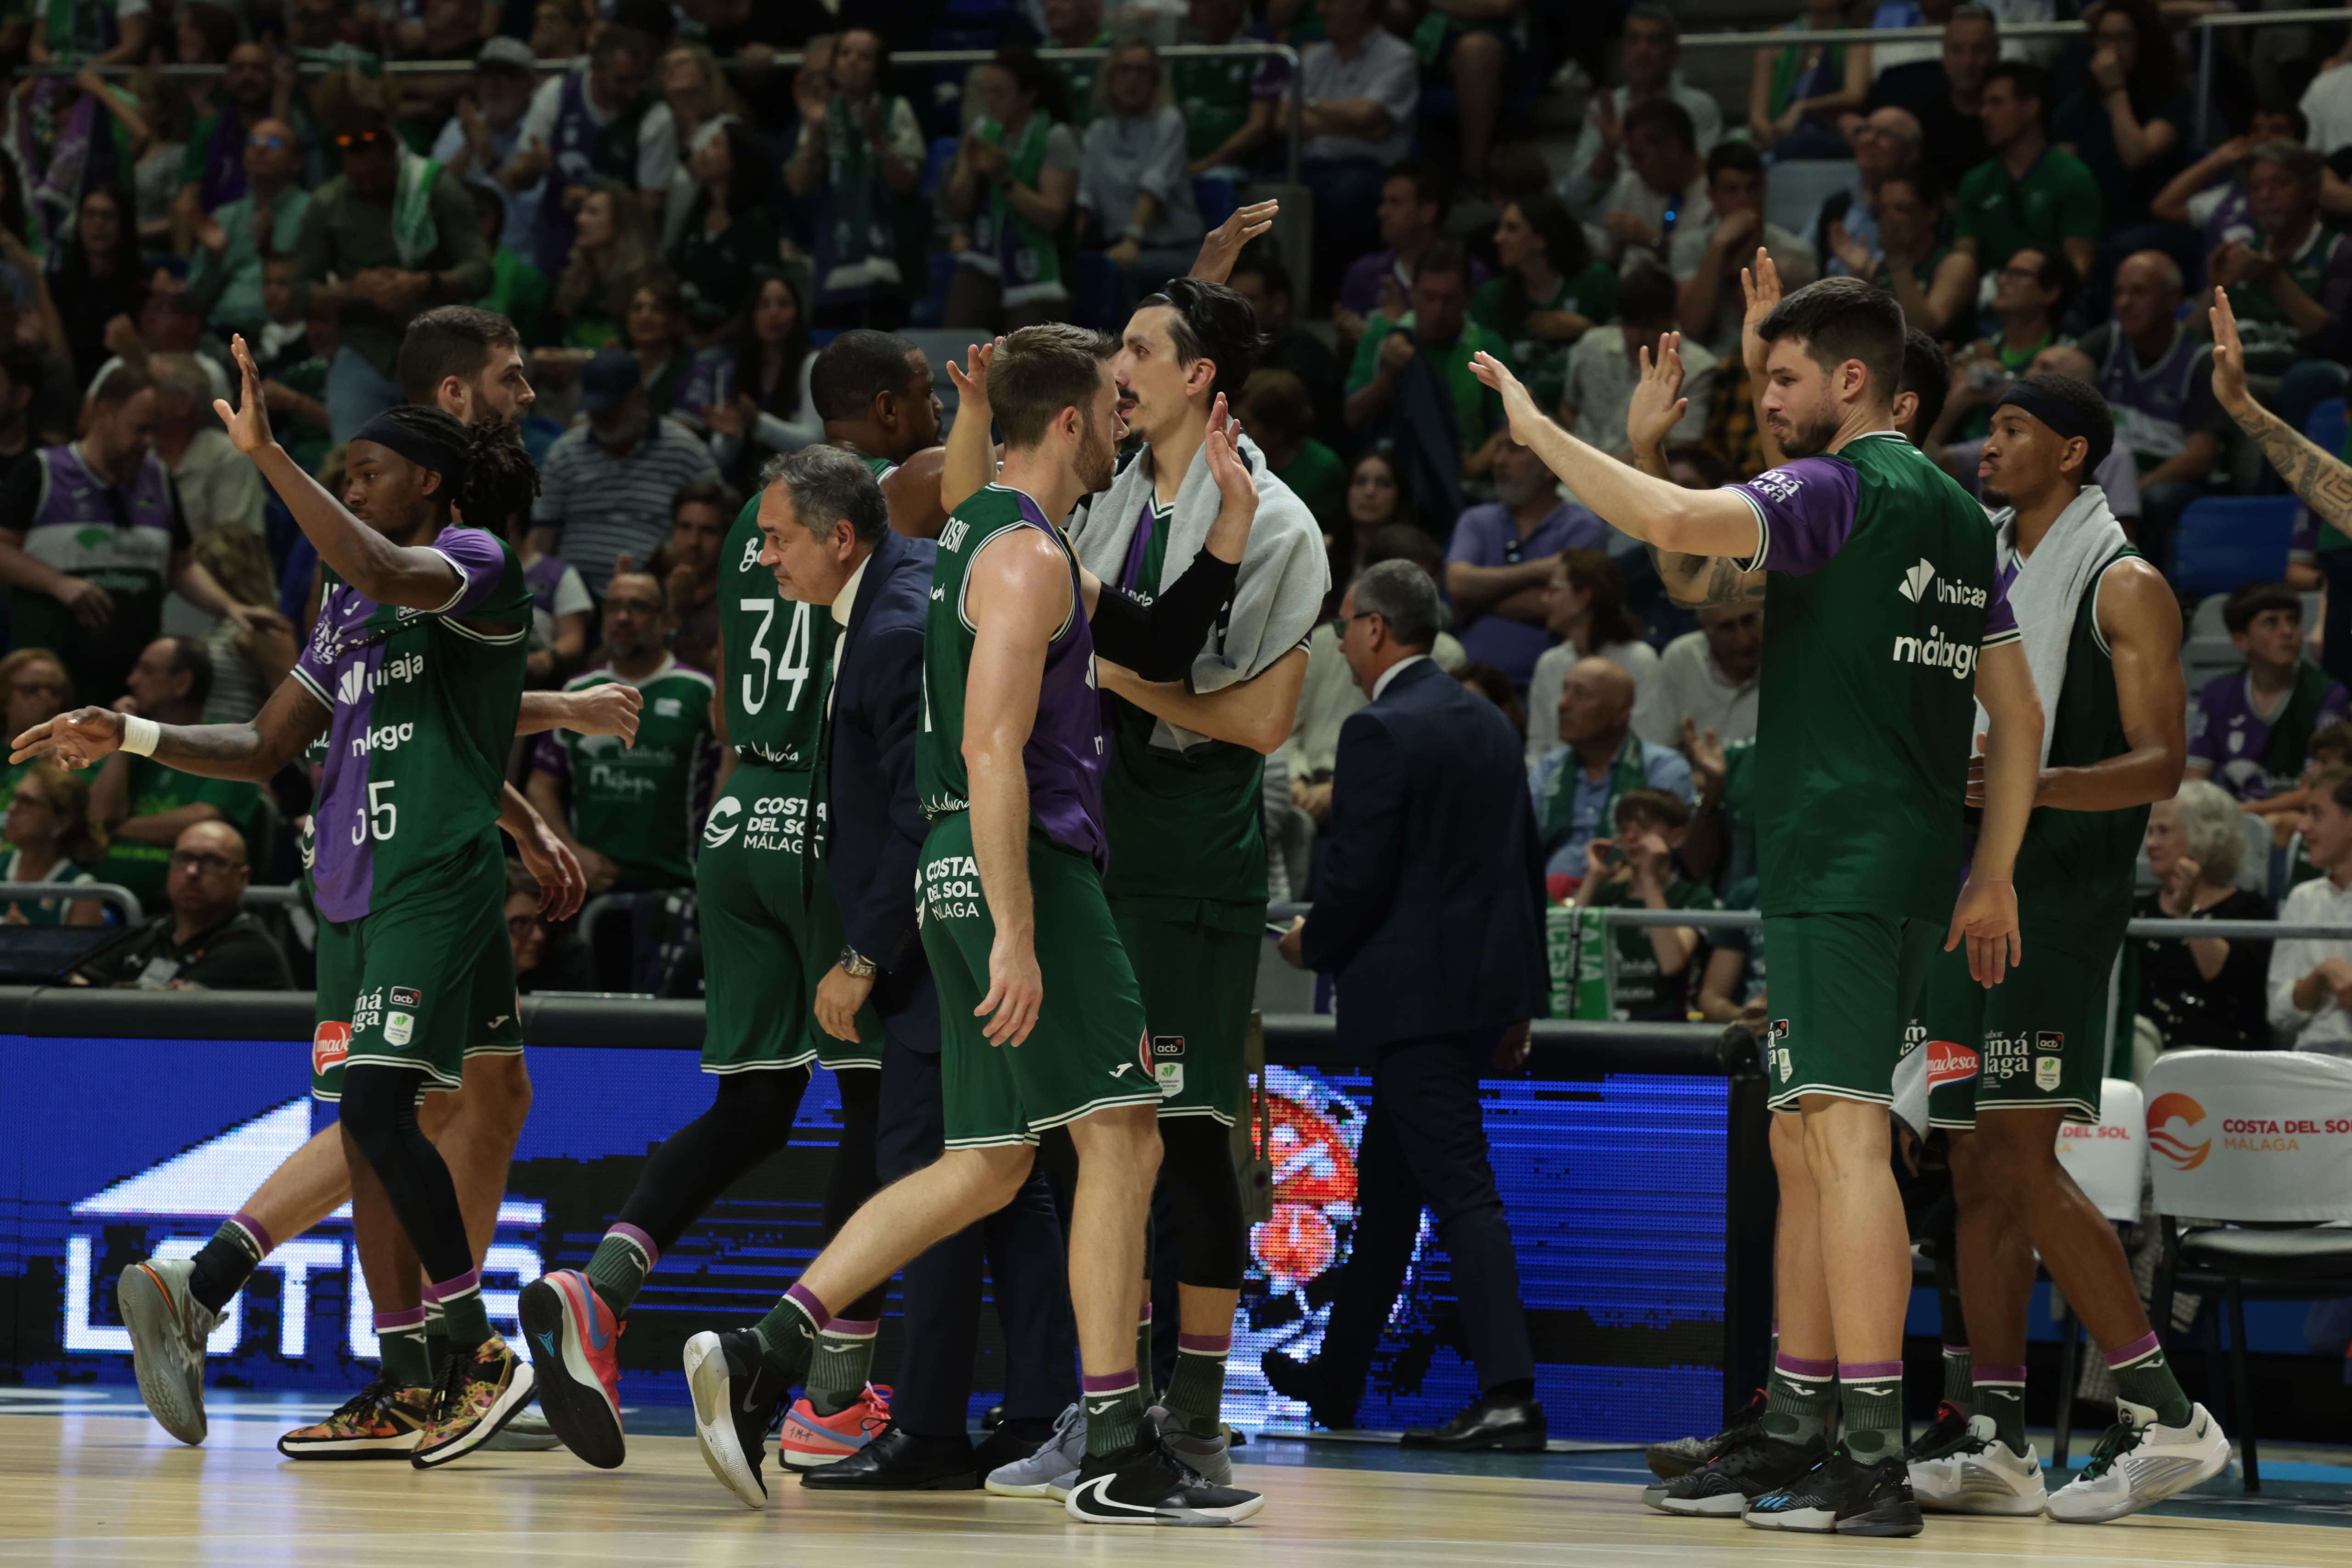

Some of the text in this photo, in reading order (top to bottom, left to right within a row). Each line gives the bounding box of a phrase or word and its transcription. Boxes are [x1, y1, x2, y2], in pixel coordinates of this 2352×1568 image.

[740, 598, 810, 715] 34
[753, 797, 826, 821] COSTA
[746, 817, 780, 832] DEL
[926, 856, 979, 882] COSTA
[927, 881, 979, 903] DEL SOL
[393, 993, 414, 1004] acb
[1157, 1044, 1178, 1053] acb
[2039, 1039, 2058, 1048] acb
[1984, 1051, 2031, 1079] laga
[2062, 1126, 2131, 1140] DEL SOL
[2222, 1119, 2352, 1134] COSTA DEL SO
[2224, 1135, 2300, 1152] MÁLAGA
